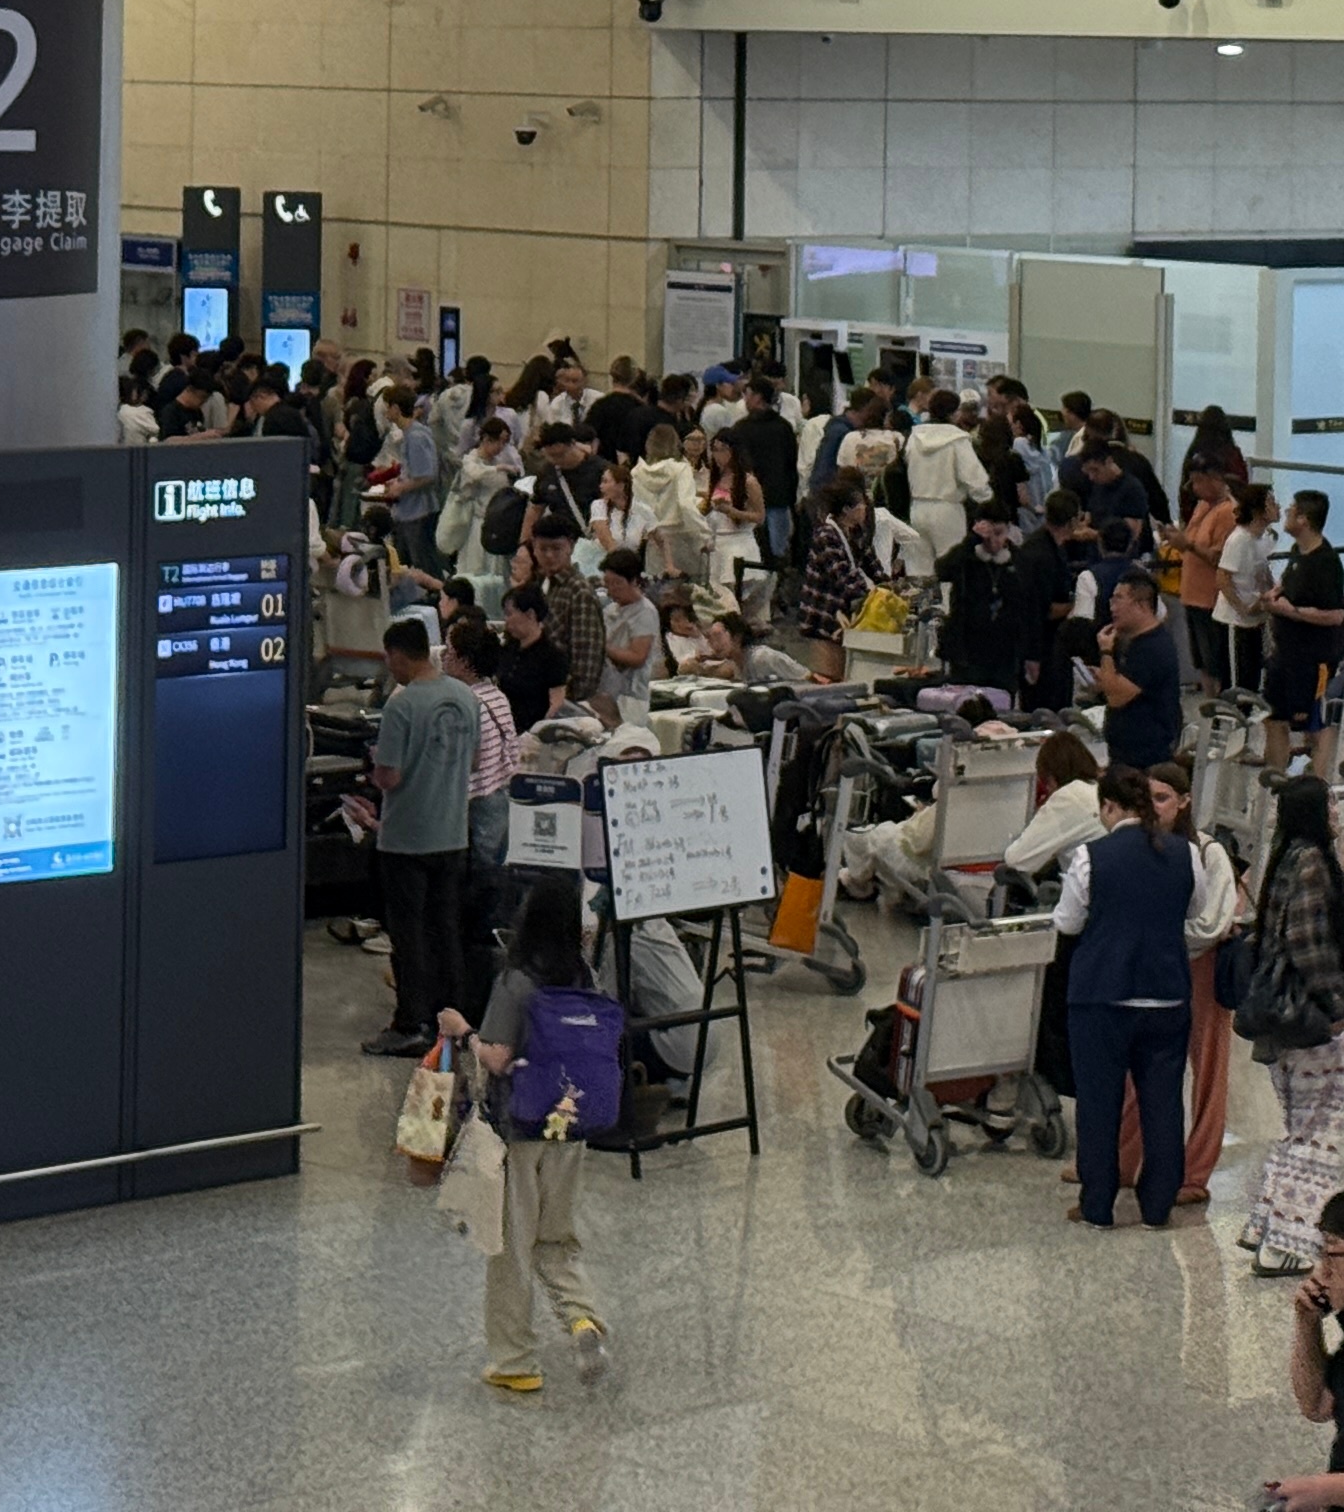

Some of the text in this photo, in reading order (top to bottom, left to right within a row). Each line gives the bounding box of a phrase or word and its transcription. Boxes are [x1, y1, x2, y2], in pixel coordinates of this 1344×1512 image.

[50, 232, 87, 251] Claim
[187, 477, 256, 501] 航班信息
[187, 502, 220, 523] Flight
[162, 565, 180, 583] T2
[261, 593, 286, 618] 01
[260, 637, 286, 662] 02
